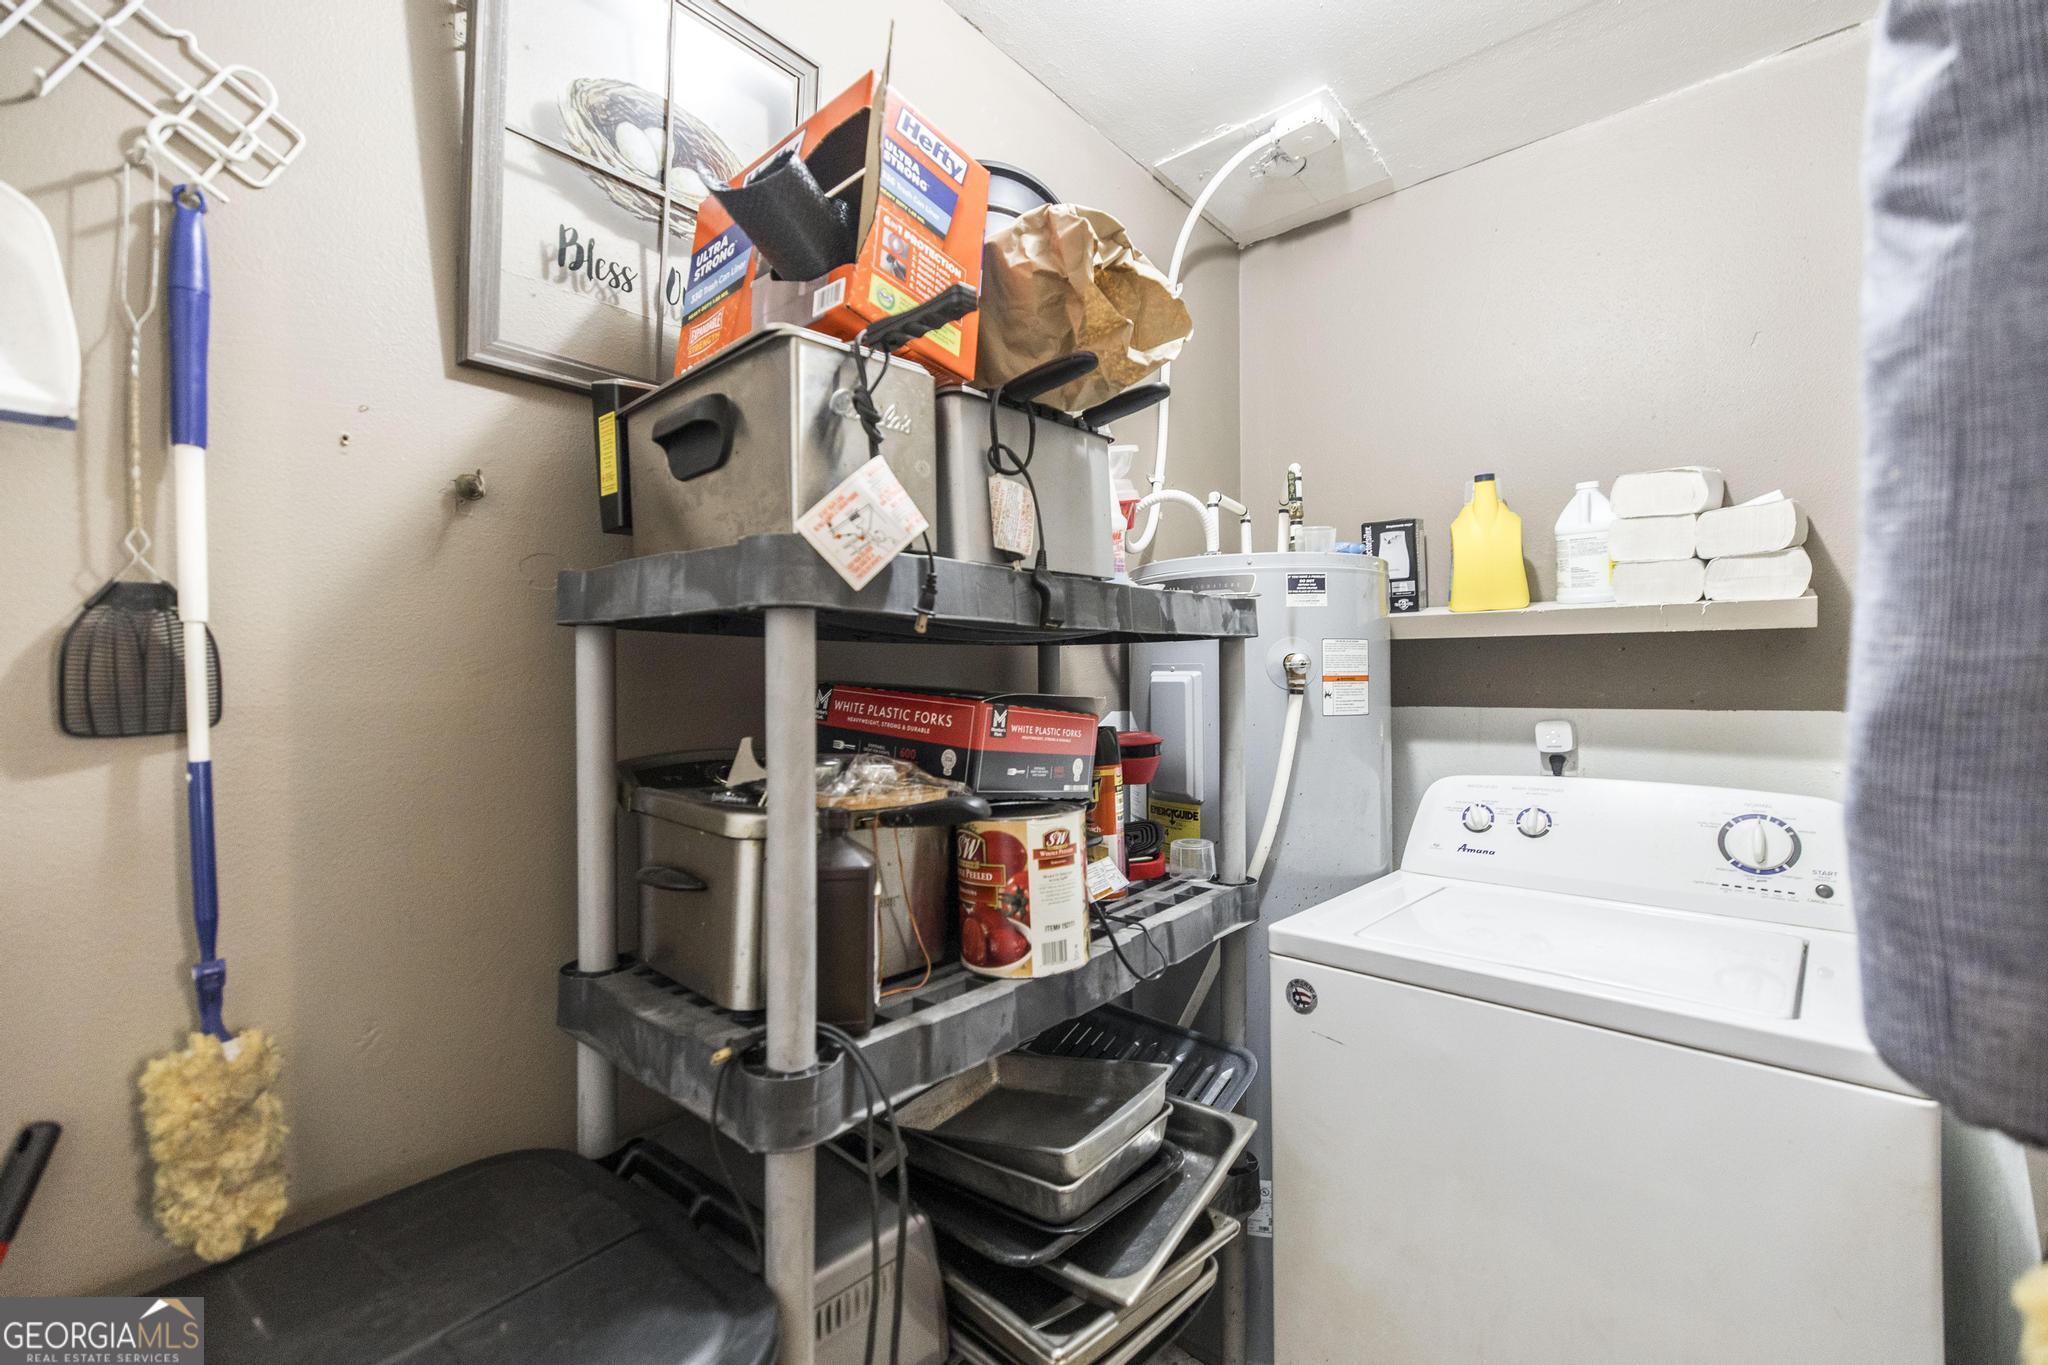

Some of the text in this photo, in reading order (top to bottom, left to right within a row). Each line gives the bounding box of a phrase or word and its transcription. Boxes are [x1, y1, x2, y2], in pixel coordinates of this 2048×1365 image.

[884, 138, 921, 174] ULTRA
[901, 115, 963, 178] Hefty
[883, 150, 928, 192] STRONG
[558, 223, 638, 293] Bless
[693, 243, 736, 282] STRONG
[696, 235, 729, 266] ULTRA
[904, 228, 962, 279] PROTECTION
[719, 271, 731, 284] Can
[834, 699, 866, 715] WHITE
[867, 705, 910, 722] PLASTIC
[914, 711, 953, 728] FORKS
[881, 721, 901, 731] STRONG
[906, 724, 930, 735] DURABLE
[1011, 724, 1082, 738] WHITE PLASTIC FORKS
[1457, 843, 1496, 856] Amana
[1811, 869, 1838, 877] START
